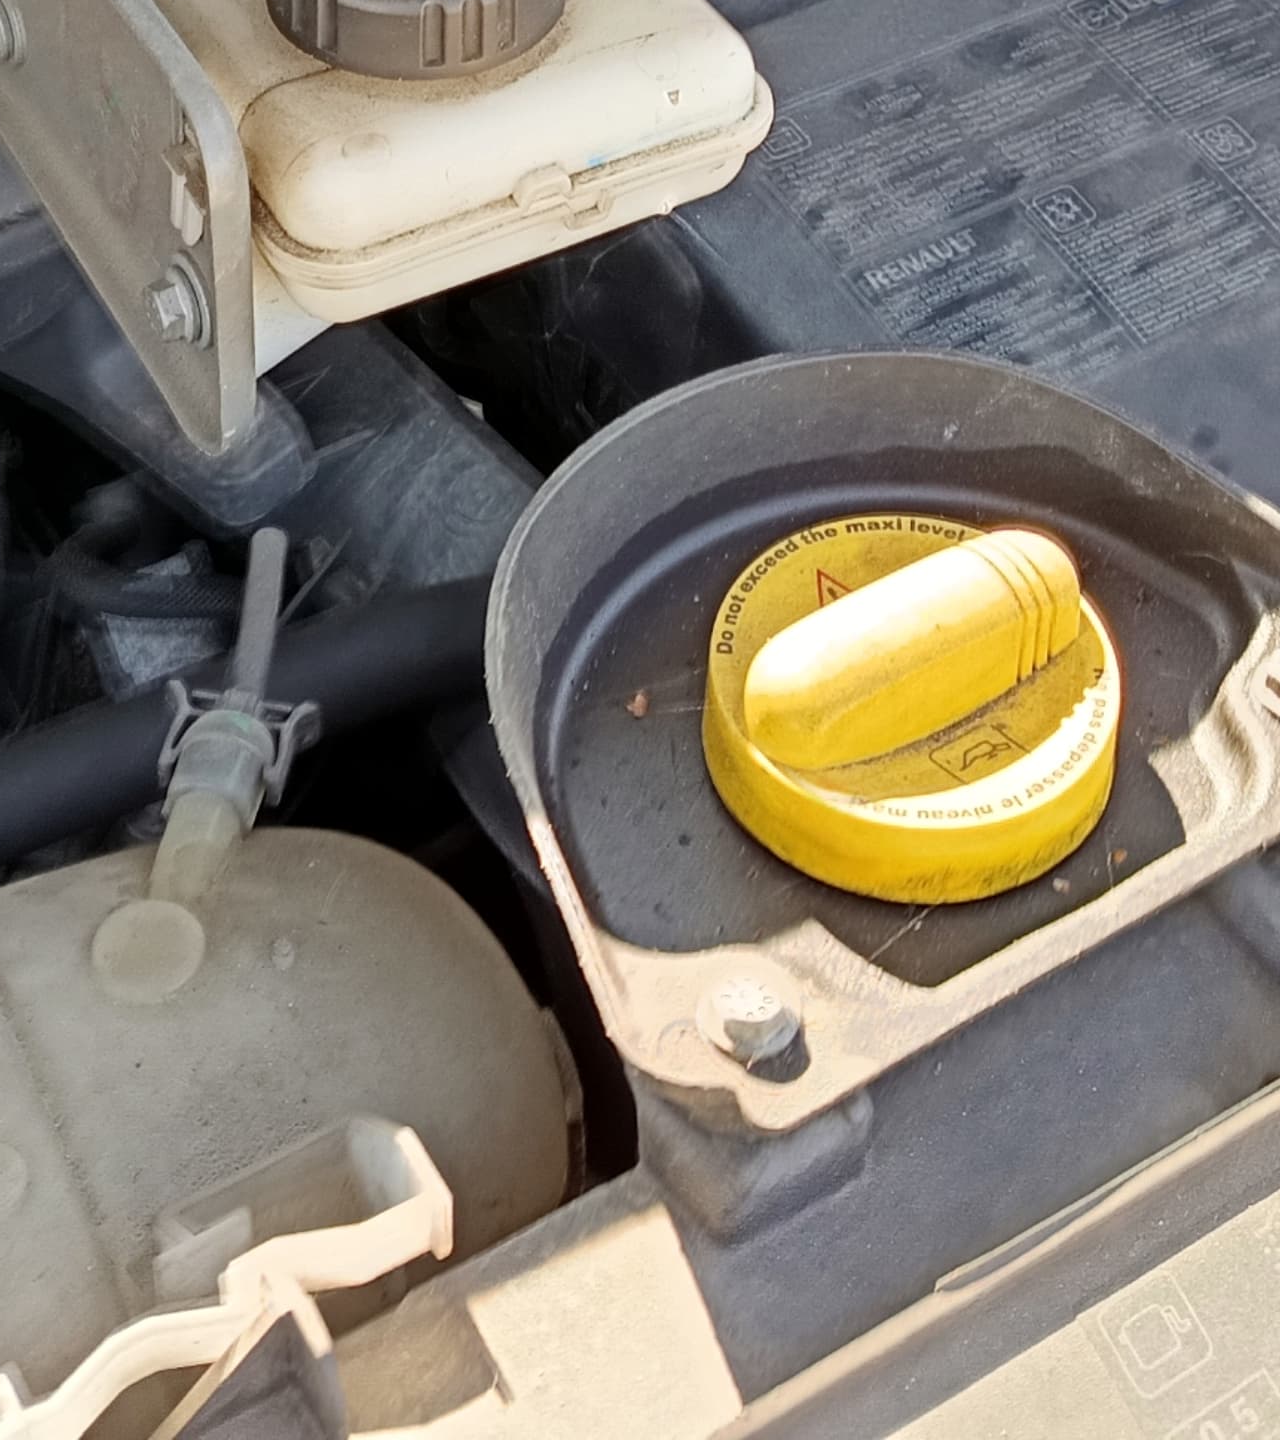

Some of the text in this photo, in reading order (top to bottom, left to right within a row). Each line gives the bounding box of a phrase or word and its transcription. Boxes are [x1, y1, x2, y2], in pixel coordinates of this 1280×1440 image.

[863, 227, 978, 291] RENAULT
[715, 517, 966, 656] Do not exceed the maxi level
[1088, 698, 1107, 729] pas
[917, 802, 993, 820] niveau
[1001, 794, 1024, 810] le
